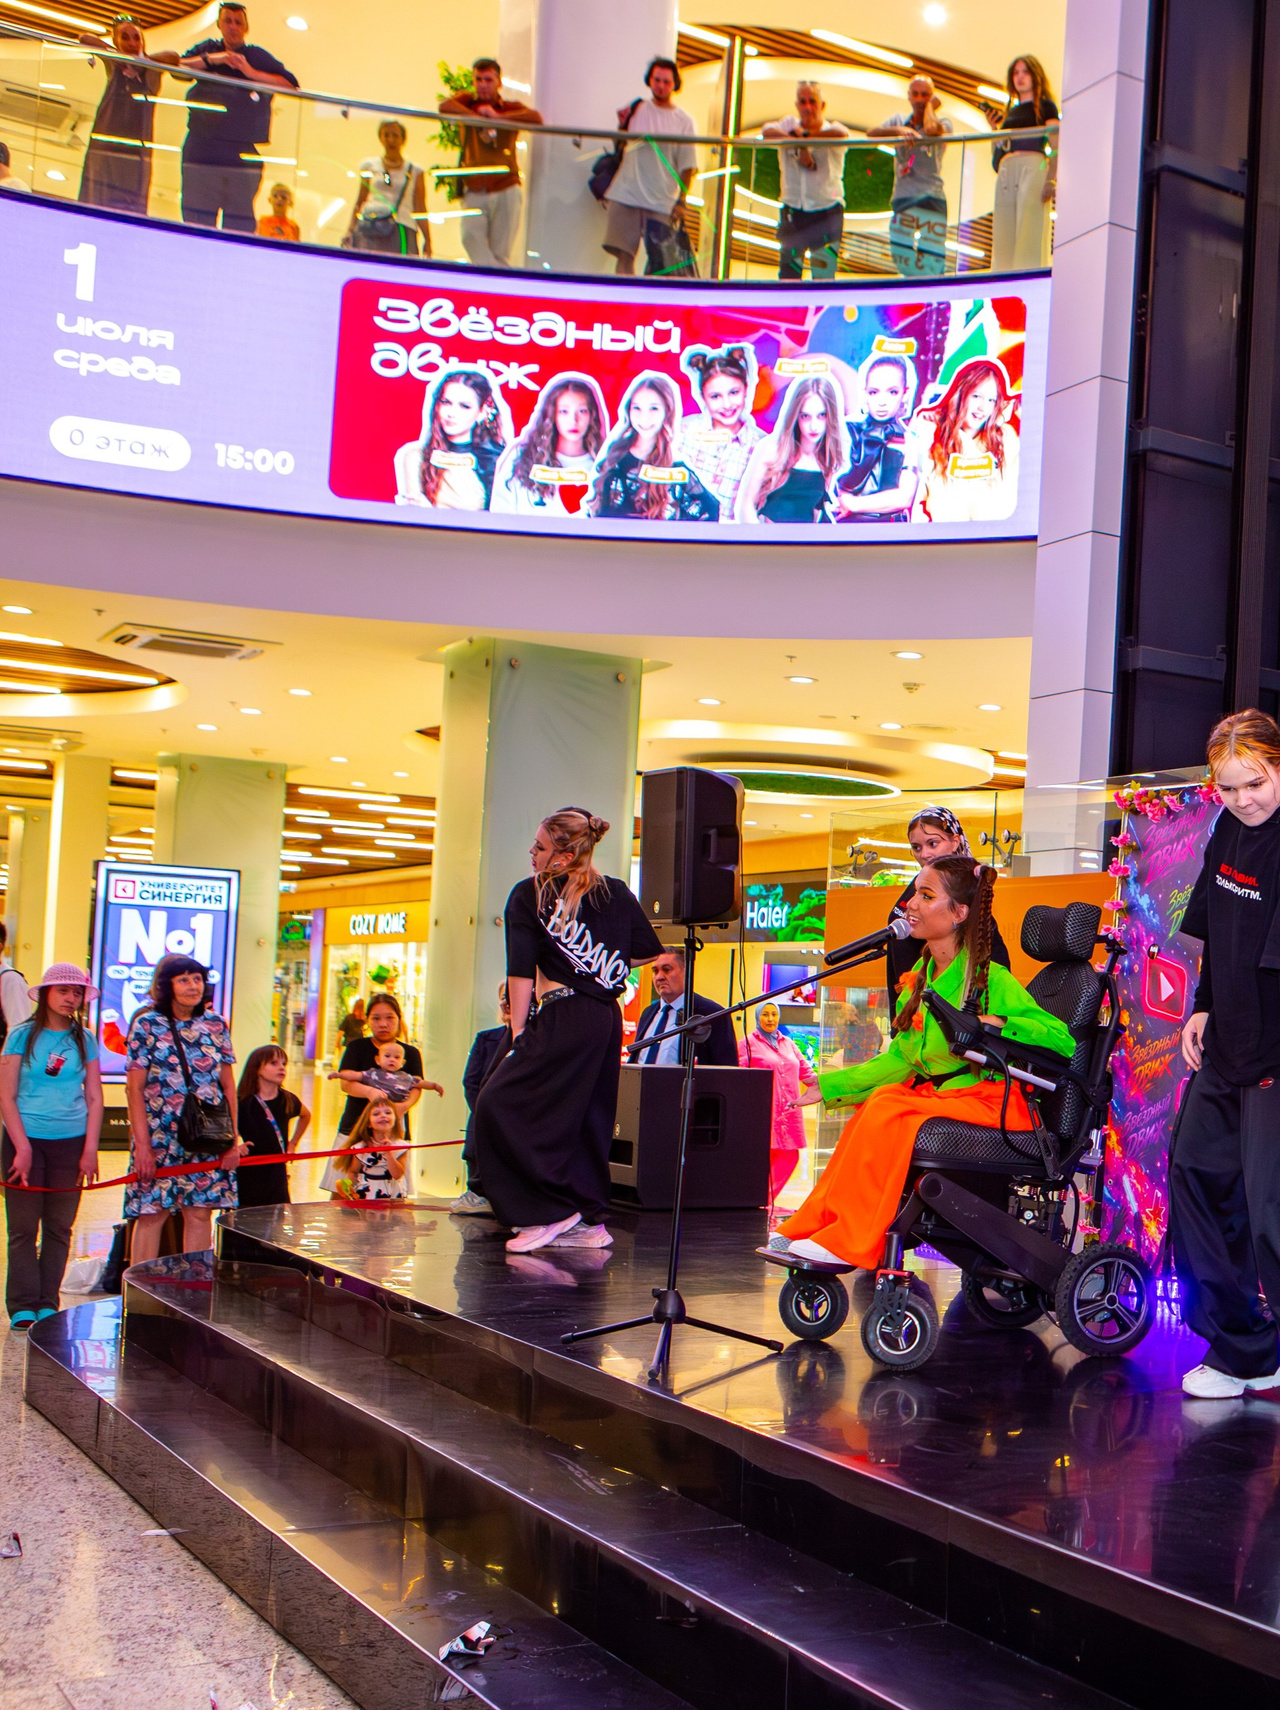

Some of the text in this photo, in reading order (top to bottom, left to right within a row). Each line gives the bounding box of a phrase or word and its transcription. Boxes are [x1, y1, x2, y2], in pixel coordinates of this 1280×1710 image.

[63, 242, 97, 302] 1
[56, 313, 174, 350] июля
[53, 348, 181, 386] среда
[69, 428, 170, 459] 0 этаж
[214, 442, 295, 475] 15:00
[139, 889, 223, 905] СИНЕРГИЯ
[140, 880, 223, 893] УНИВЕРСИТЕТ
[350, 911, 407, 936] COZY HOME
[746, 901, 788, 929] Haier
